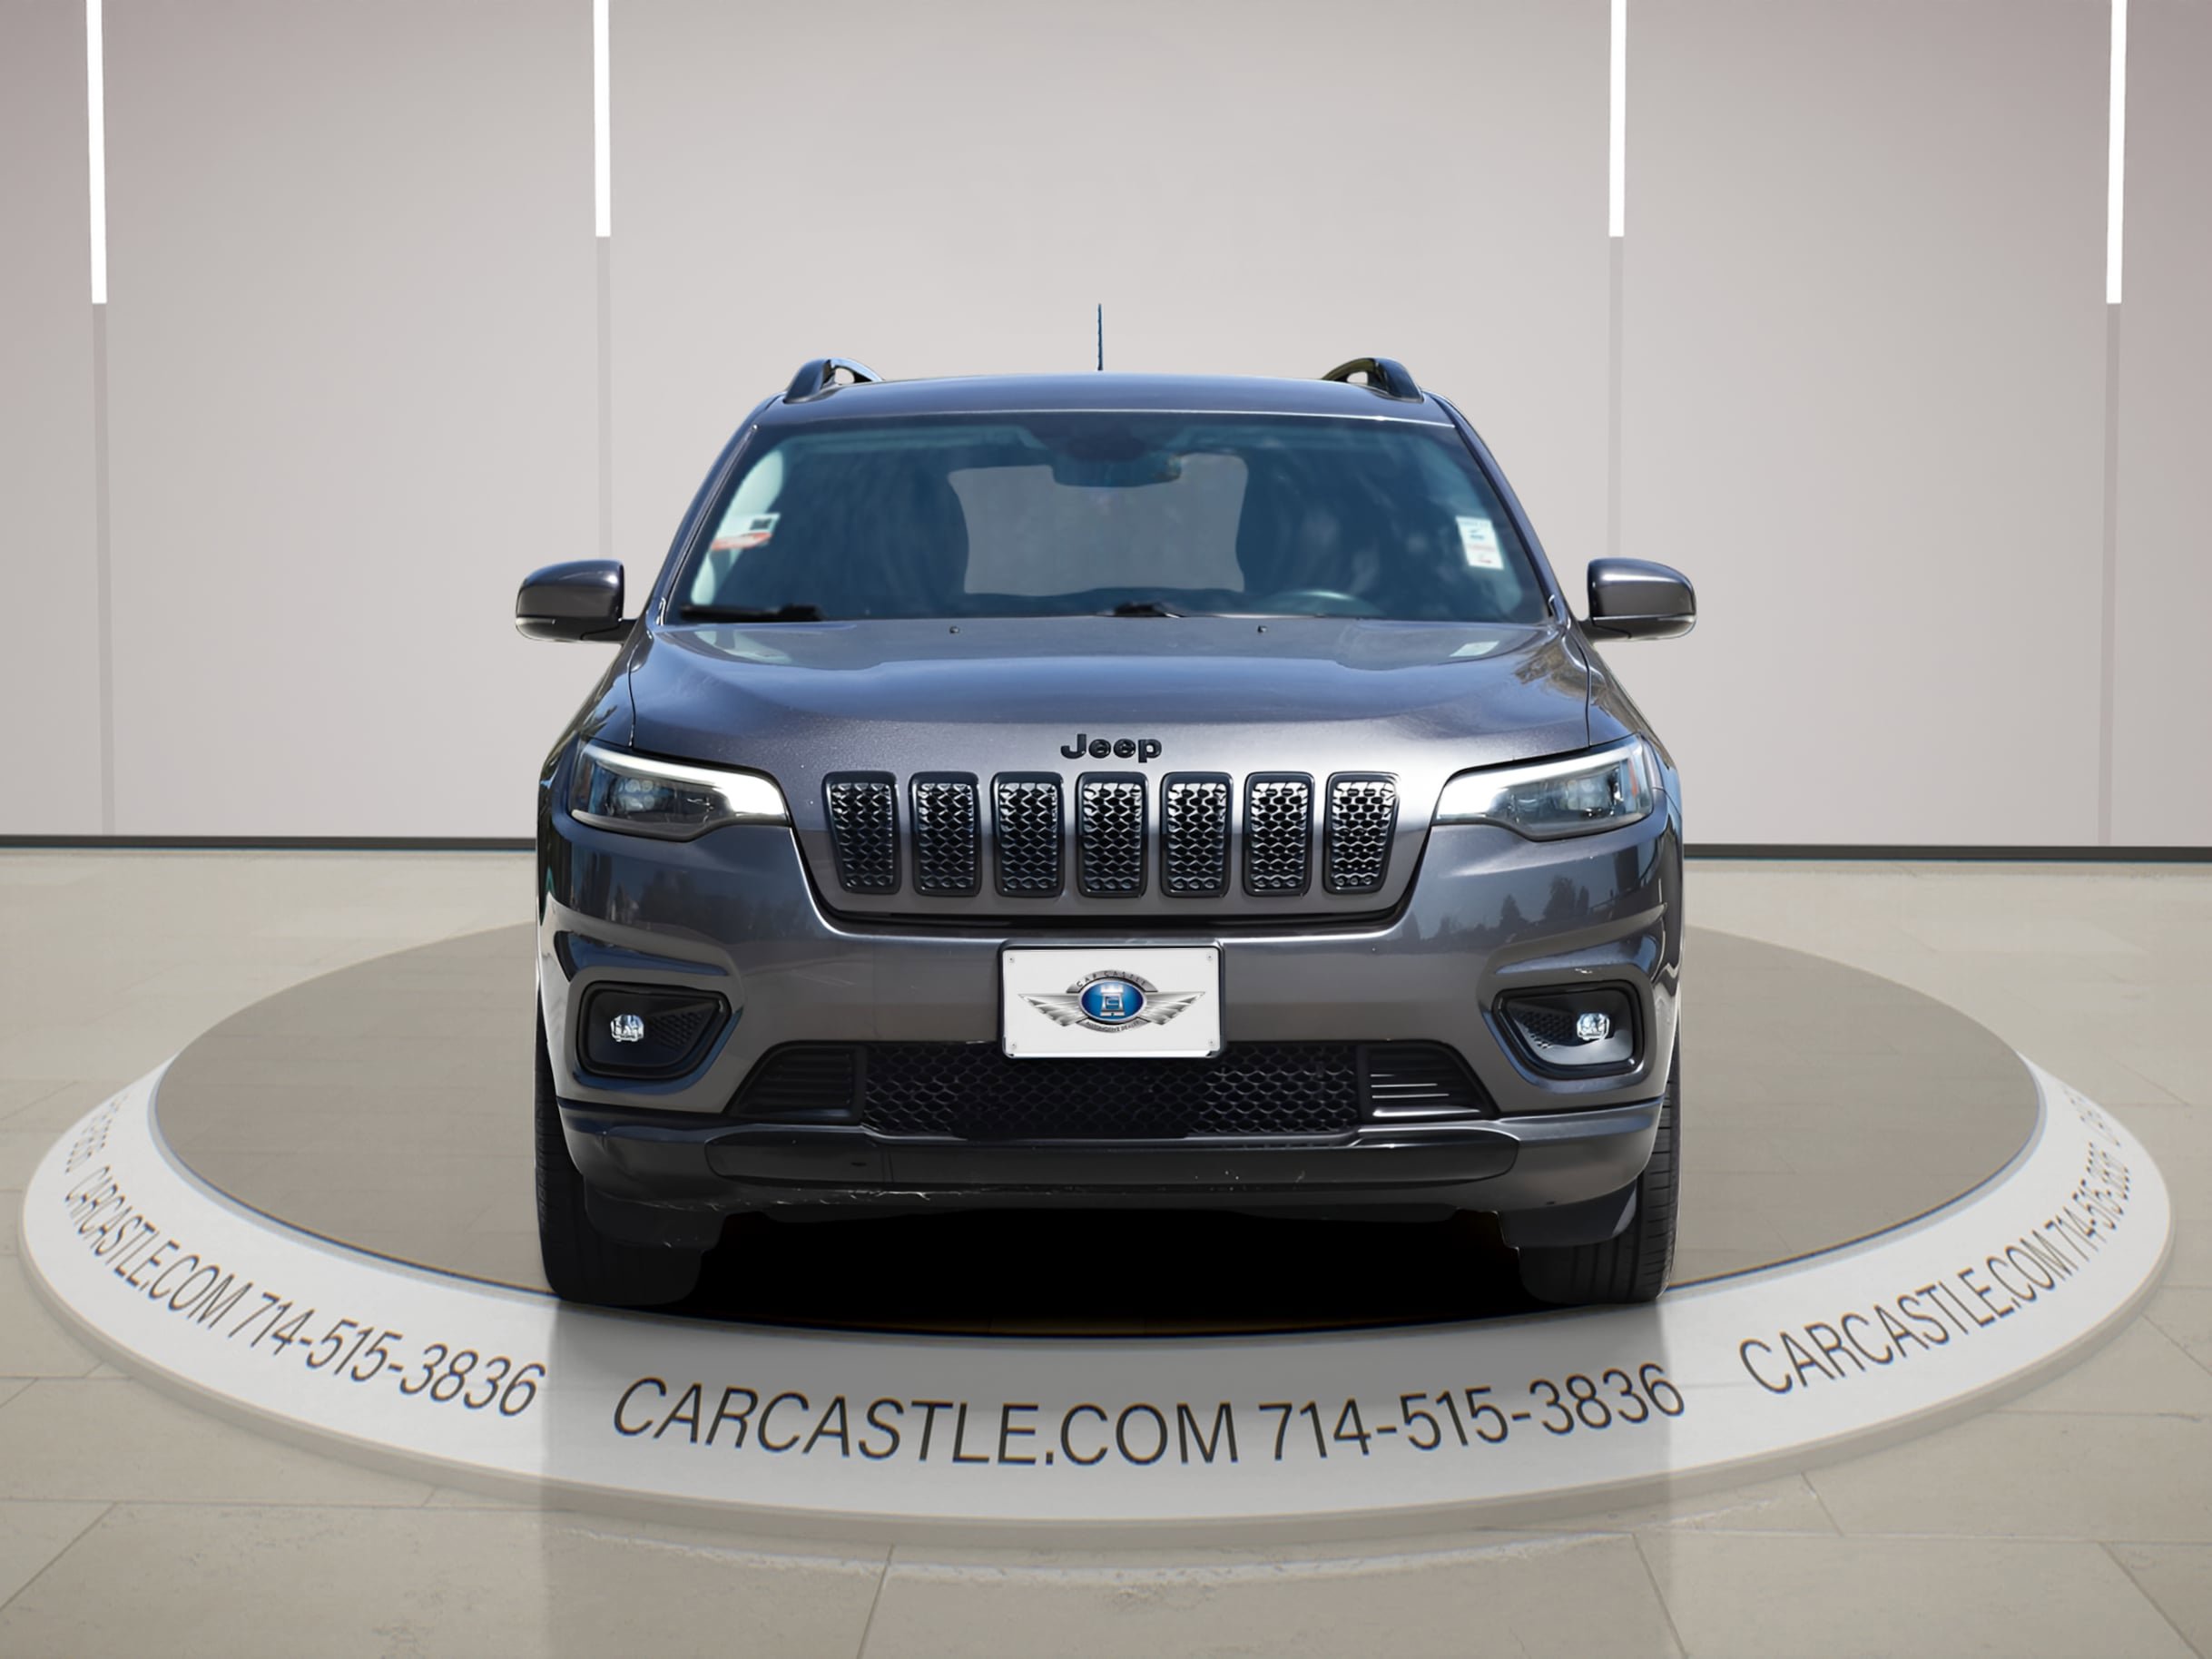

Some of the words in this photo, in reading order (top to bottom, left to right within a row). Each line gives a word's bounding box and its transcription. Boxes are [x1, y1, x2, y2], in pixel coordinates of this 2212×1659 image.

[1060, 733, 1163, 763] Jeep
[65, 1165, 253, 1330] CARCASTLE.COM
[228, 1291, 546, 1418] 714-515-3836
[1739, 1230, 2079, 1395] CARCASTLE.COM
[614, 1377, 1238, 1467] CARCASTLE.COM
[1258, 1363, 1686, 1461] 714-515-3836
